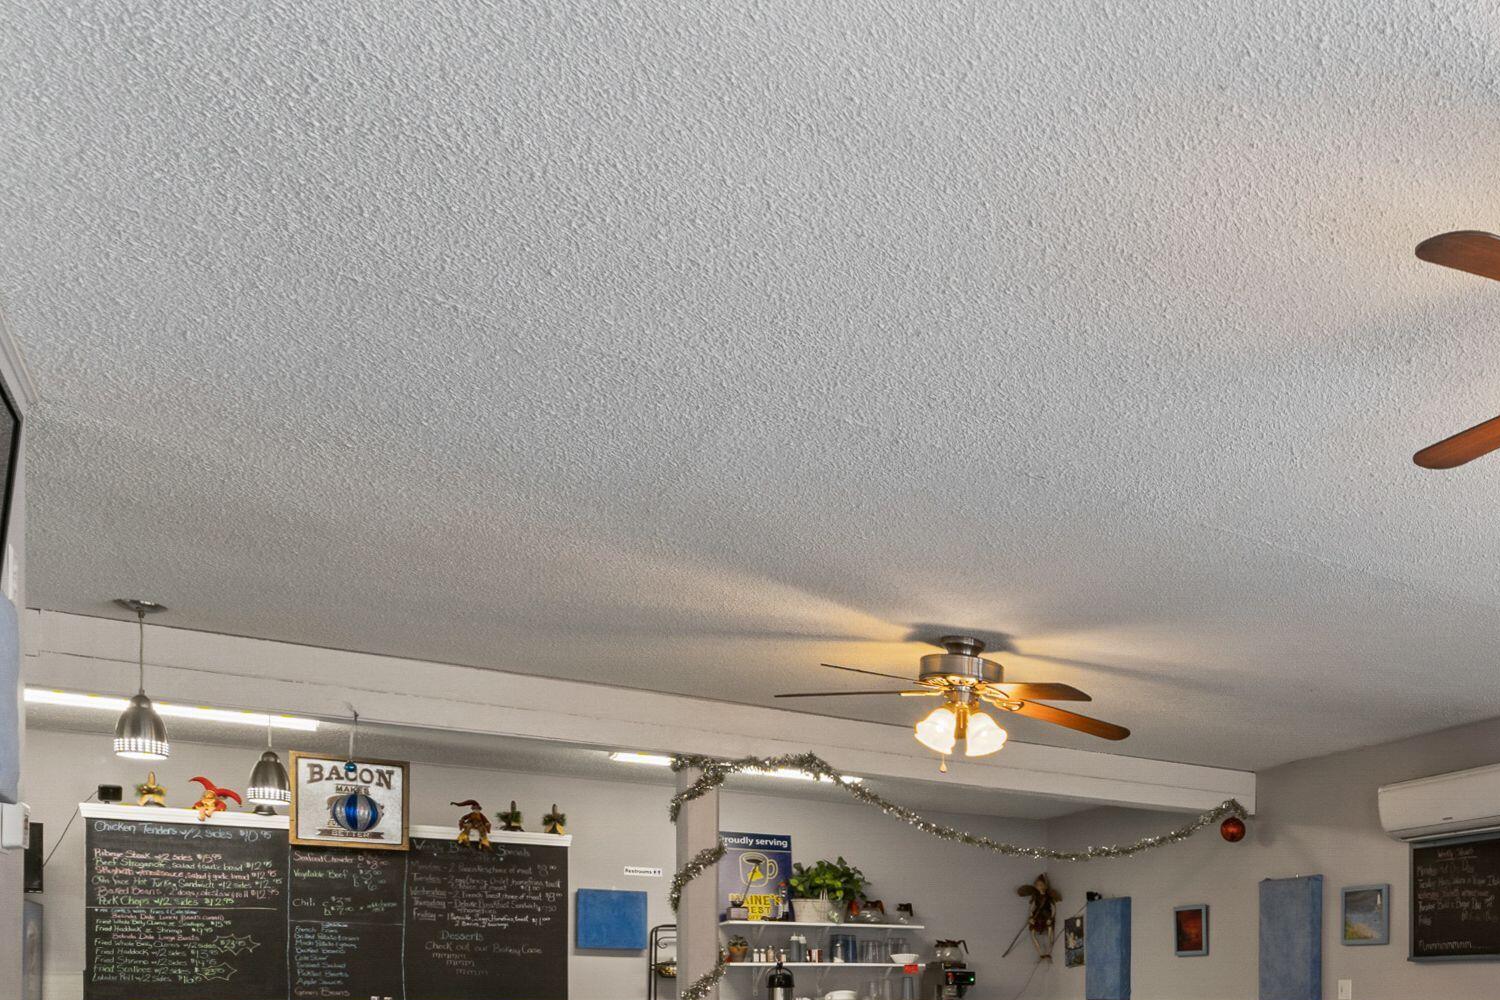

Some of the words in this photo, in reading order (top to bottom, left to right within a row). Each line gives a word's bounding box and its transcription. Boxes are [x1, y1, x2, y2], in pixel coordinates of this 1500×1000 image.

[306, 763, 395, 790] BACON
[94, 821, 136, 834] Chicken
[138, 822, 177, 835] Tenders
[331, 830, 370, 839] BETTER
[723, 836, 754, 846] roudly
[755, 838, 788, 848] serving
[748, 906, 771, 914] EST
